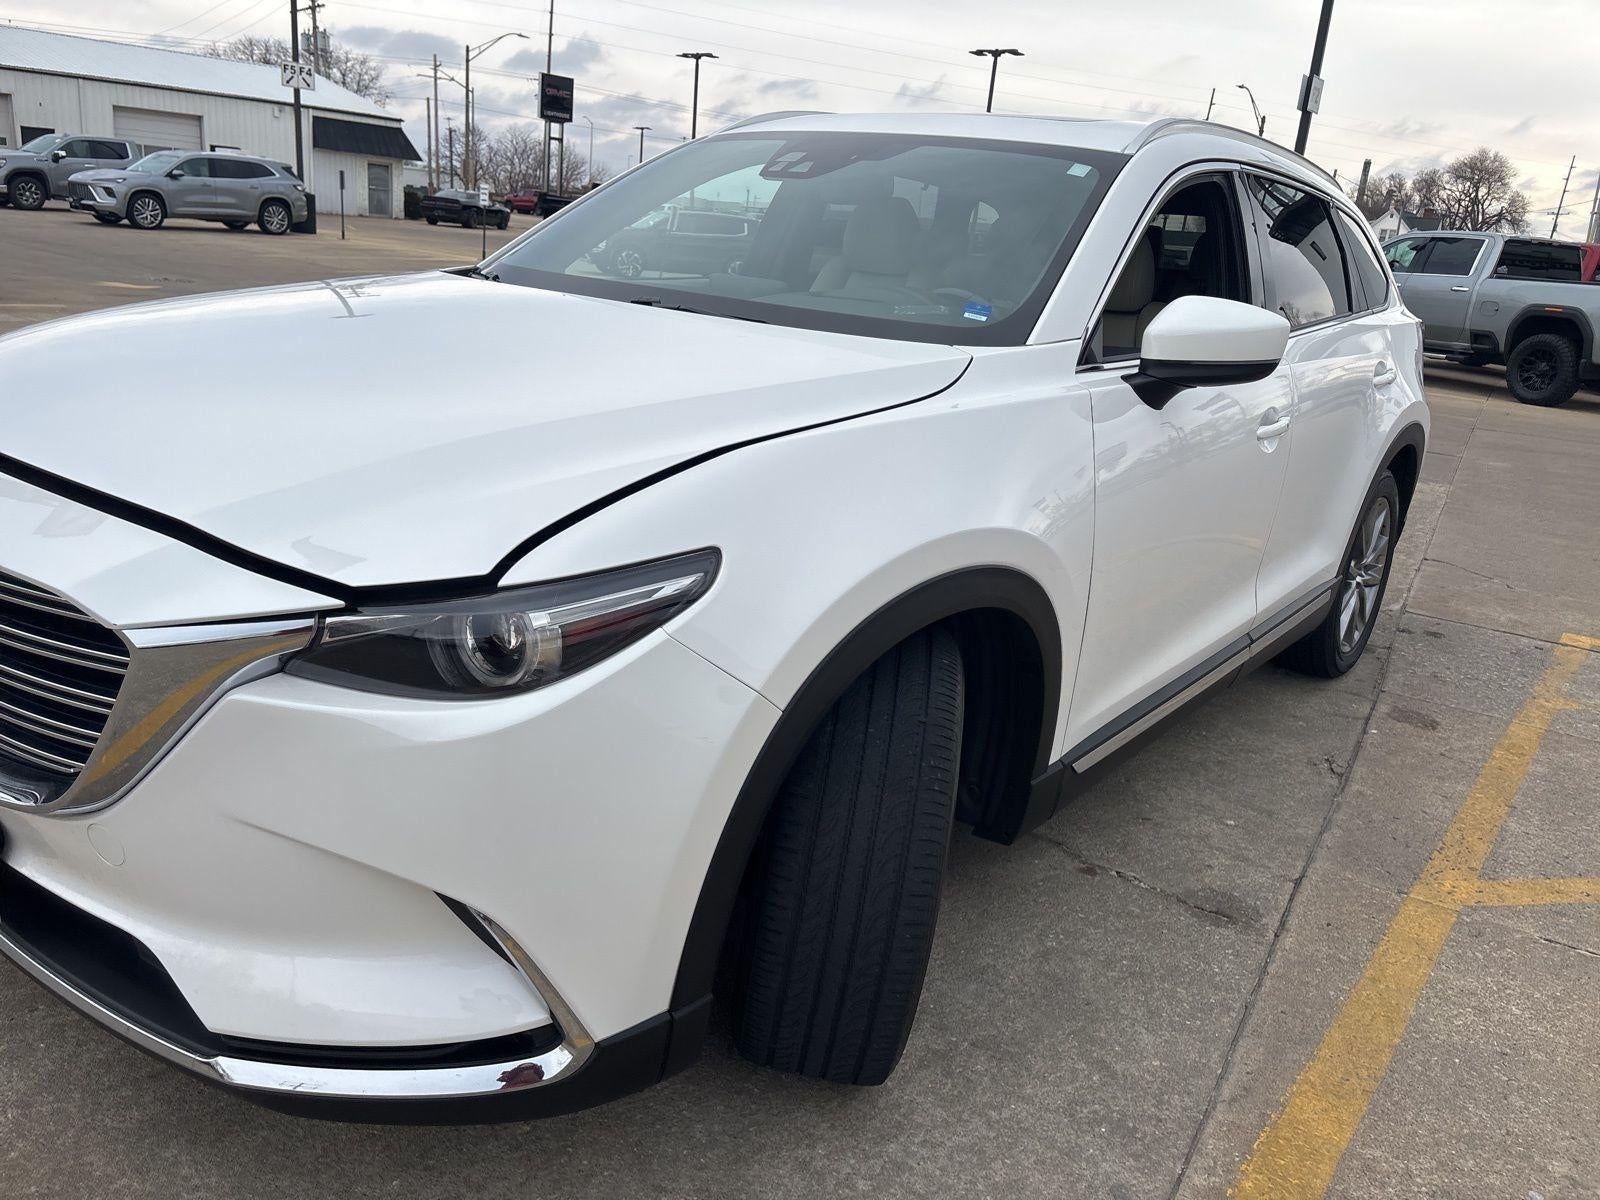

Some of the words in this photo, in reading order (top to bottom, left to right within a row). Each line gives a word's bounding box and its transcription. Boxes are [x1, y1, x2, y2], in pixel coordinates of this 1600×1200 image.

[283, 63, 296, 75] F5
[299, 66, 312, 77] F4
[545, 87, 571, 98] GMC
